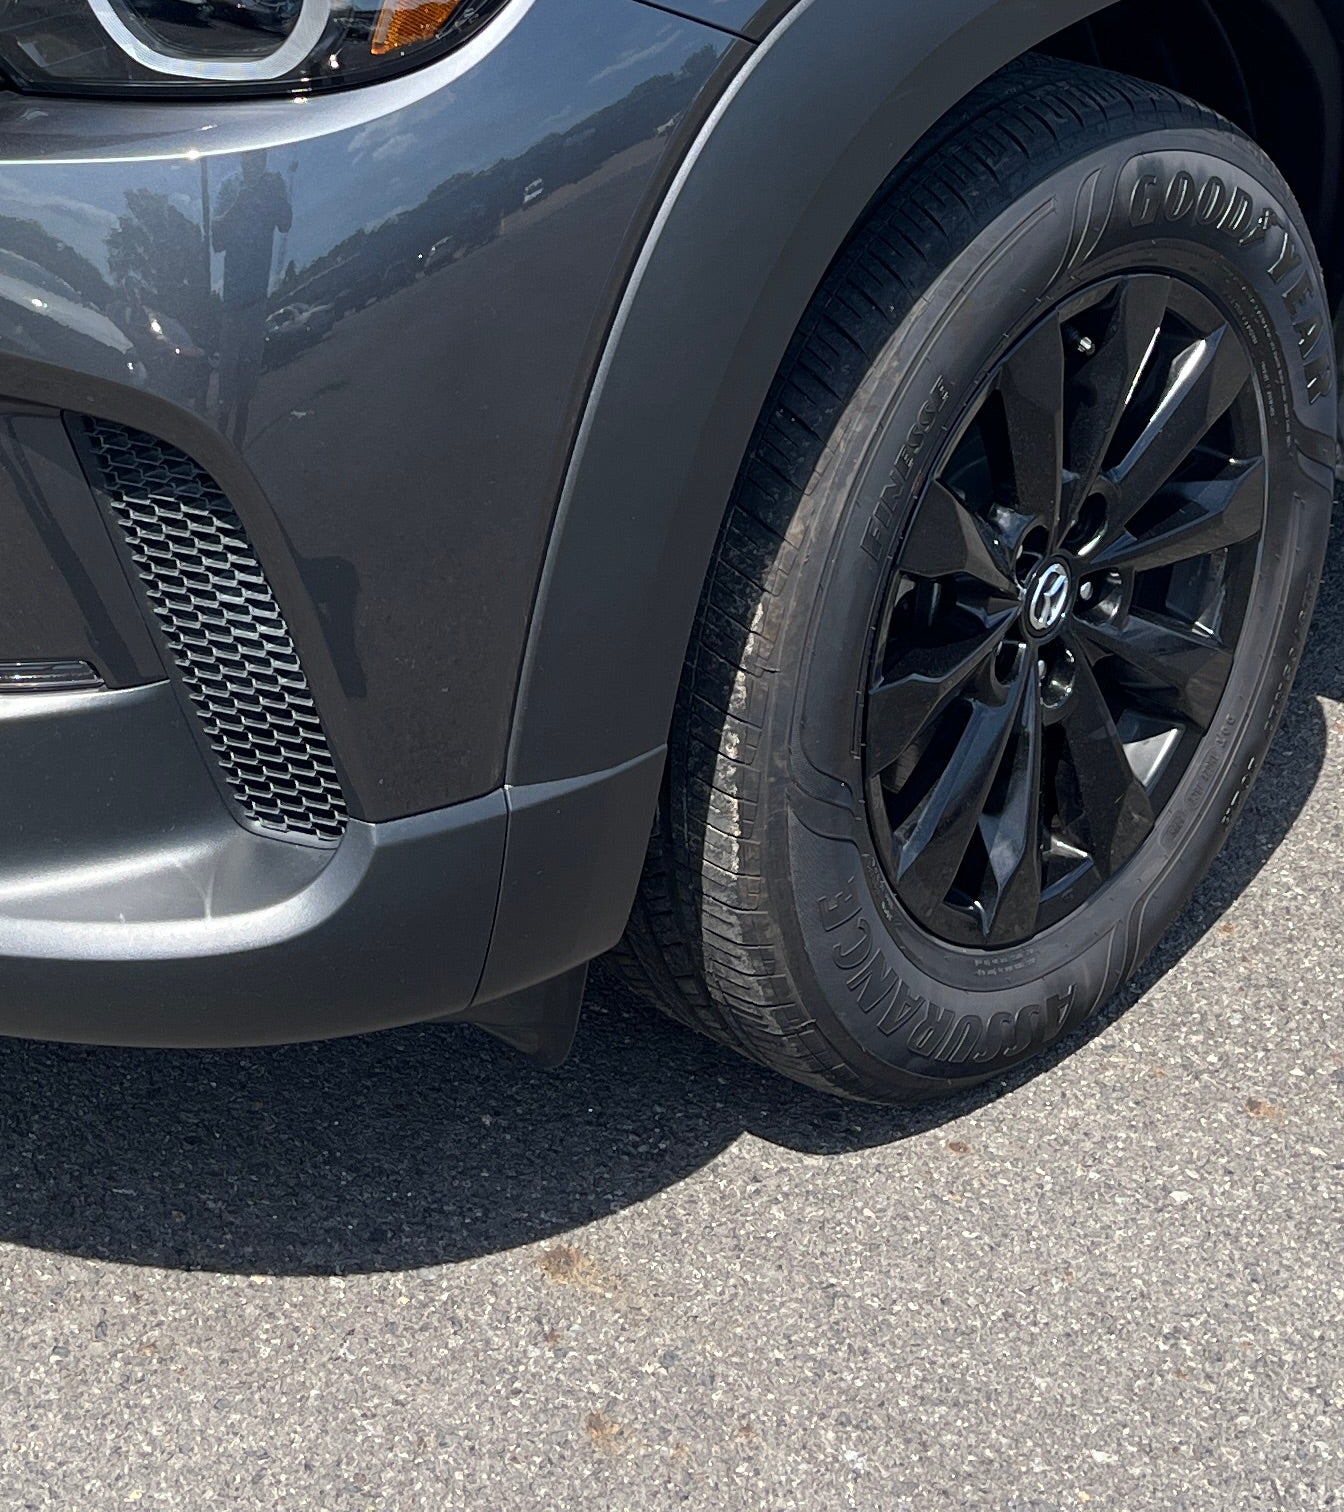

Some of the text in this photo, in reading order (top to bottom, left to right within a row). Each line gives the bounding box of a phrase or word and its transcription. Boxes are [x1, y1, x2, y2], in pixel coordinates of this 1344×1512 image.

[1129, 170, 1334, 405] GOODYEAR
[860, 374, 949, 561] FINESSE
[817, 875, 1076, 1064] ASSURANCE
